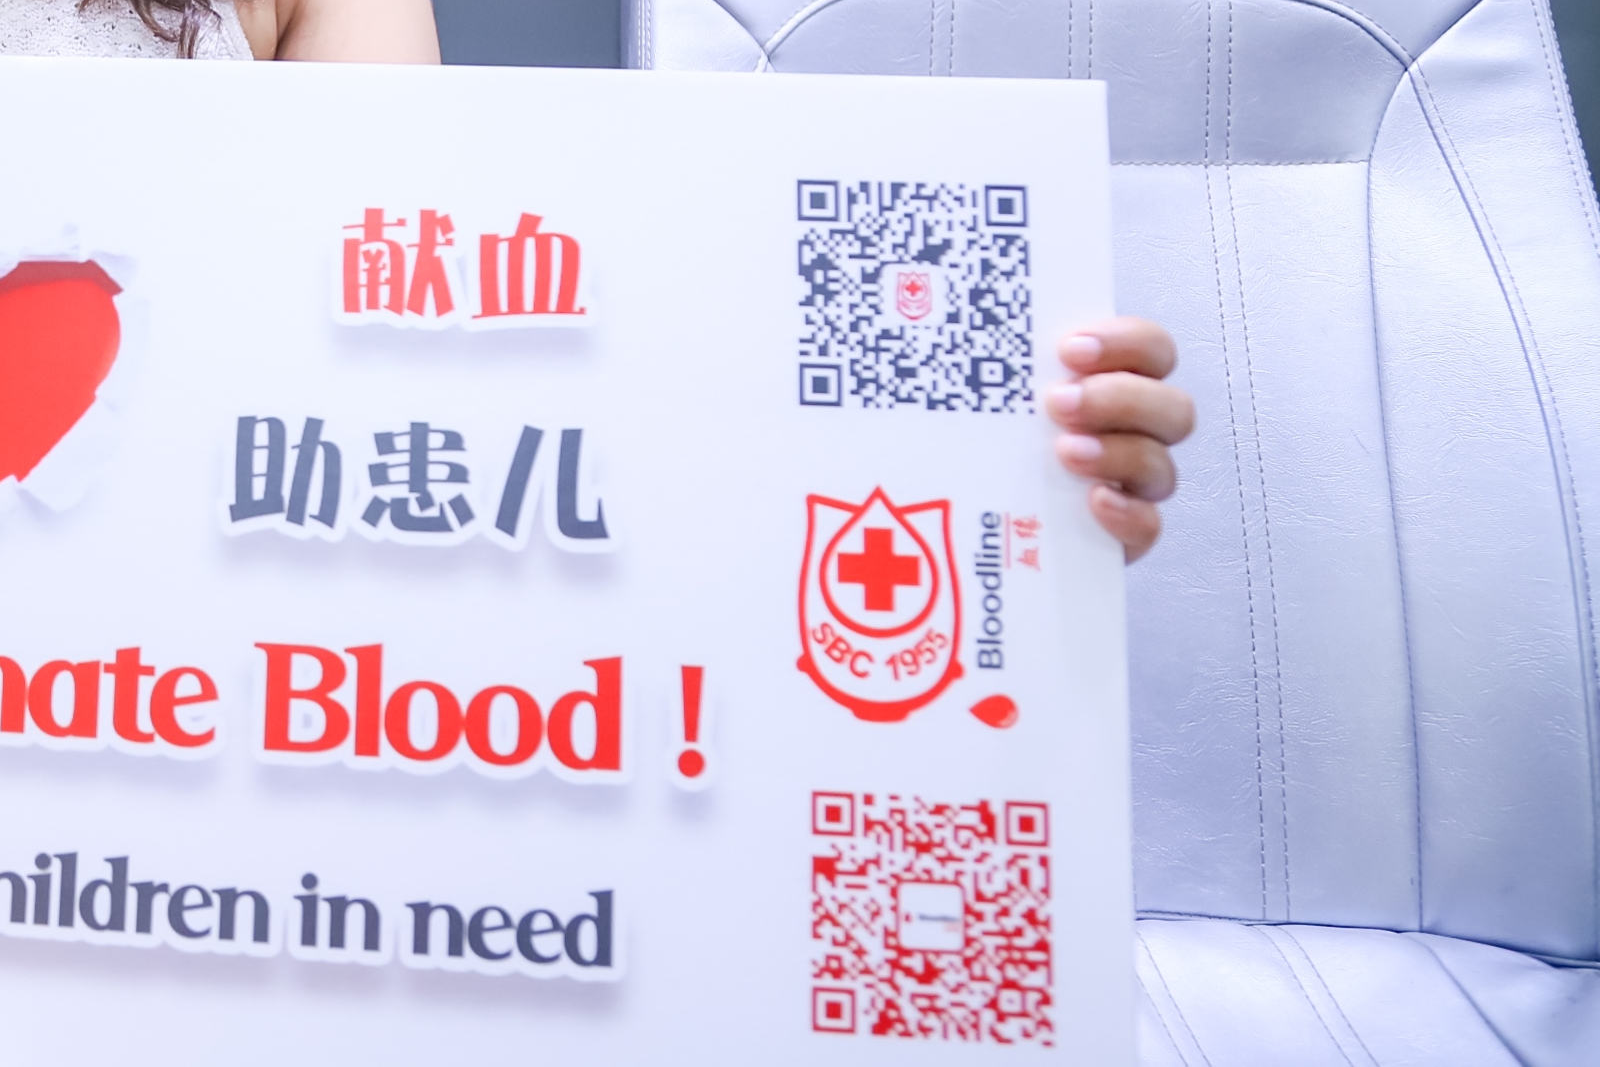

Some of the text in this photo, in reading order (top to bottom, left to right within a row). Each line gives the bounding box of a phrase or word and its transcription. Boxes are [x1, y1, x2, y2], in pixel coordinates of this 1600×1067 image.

[343, 208, 587, 319] 献血
[229, 416, 609, 540] 助患儿
[974, 511, 1003, 670] Bloodline
[254, 642, 624, 772] Blood
[811, 622, 948, 681] SBC 1955
[293, 873, 381, 952] in
[405, 889, 614, 969] need
